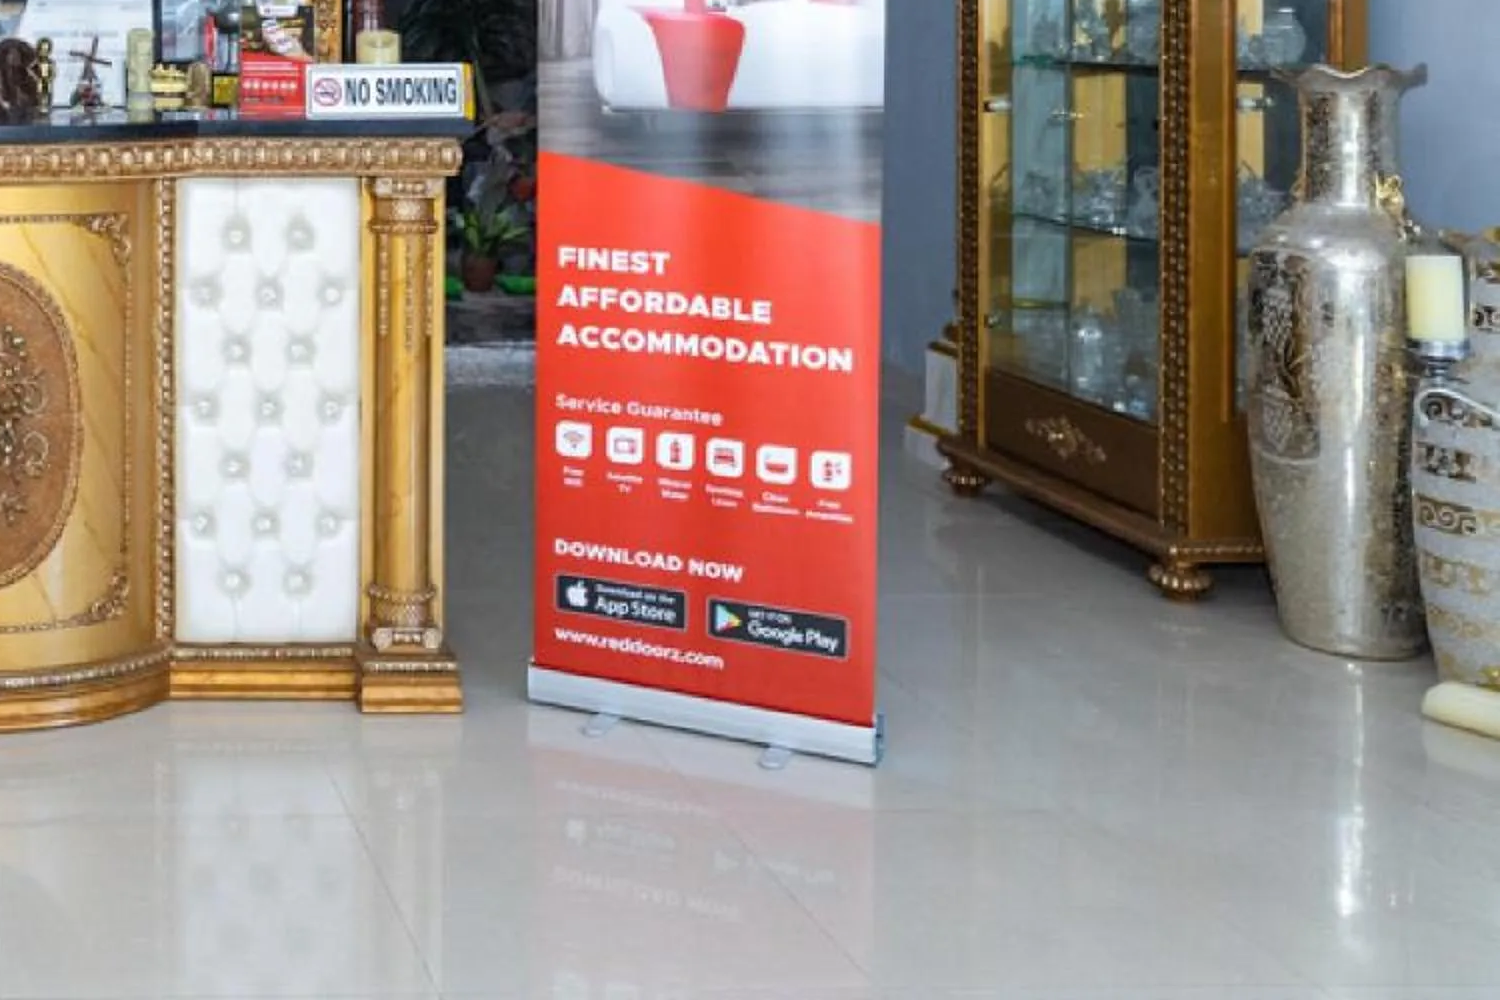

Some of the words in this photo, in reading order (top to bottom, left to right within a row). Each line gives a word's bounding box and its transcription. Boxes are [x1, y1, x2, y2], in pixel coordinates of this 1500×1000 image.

[344, 77, 371, 107] NO
[375, 76, 457, 106] SMOKING
[557, 246, 671, 275] FINEST
[557, 284, 773, 325] AFFORDABLE
[556, 323, 853, 372] ACCOMMODATION
[555, 393, 621, 415] Service
[626, 400, 723, 427] Guarantee
[555, 538, 683, 572] DOWNLOAD
[687, 558, 744, 583] NOW
[594, 596, 629, 618] App
[631, 599, 677, 624] Store
[554, 627, 725, 671] www.reddoorz.com
[747, 619, 804, 646] Google
[805, 628, 839, 653] Play
